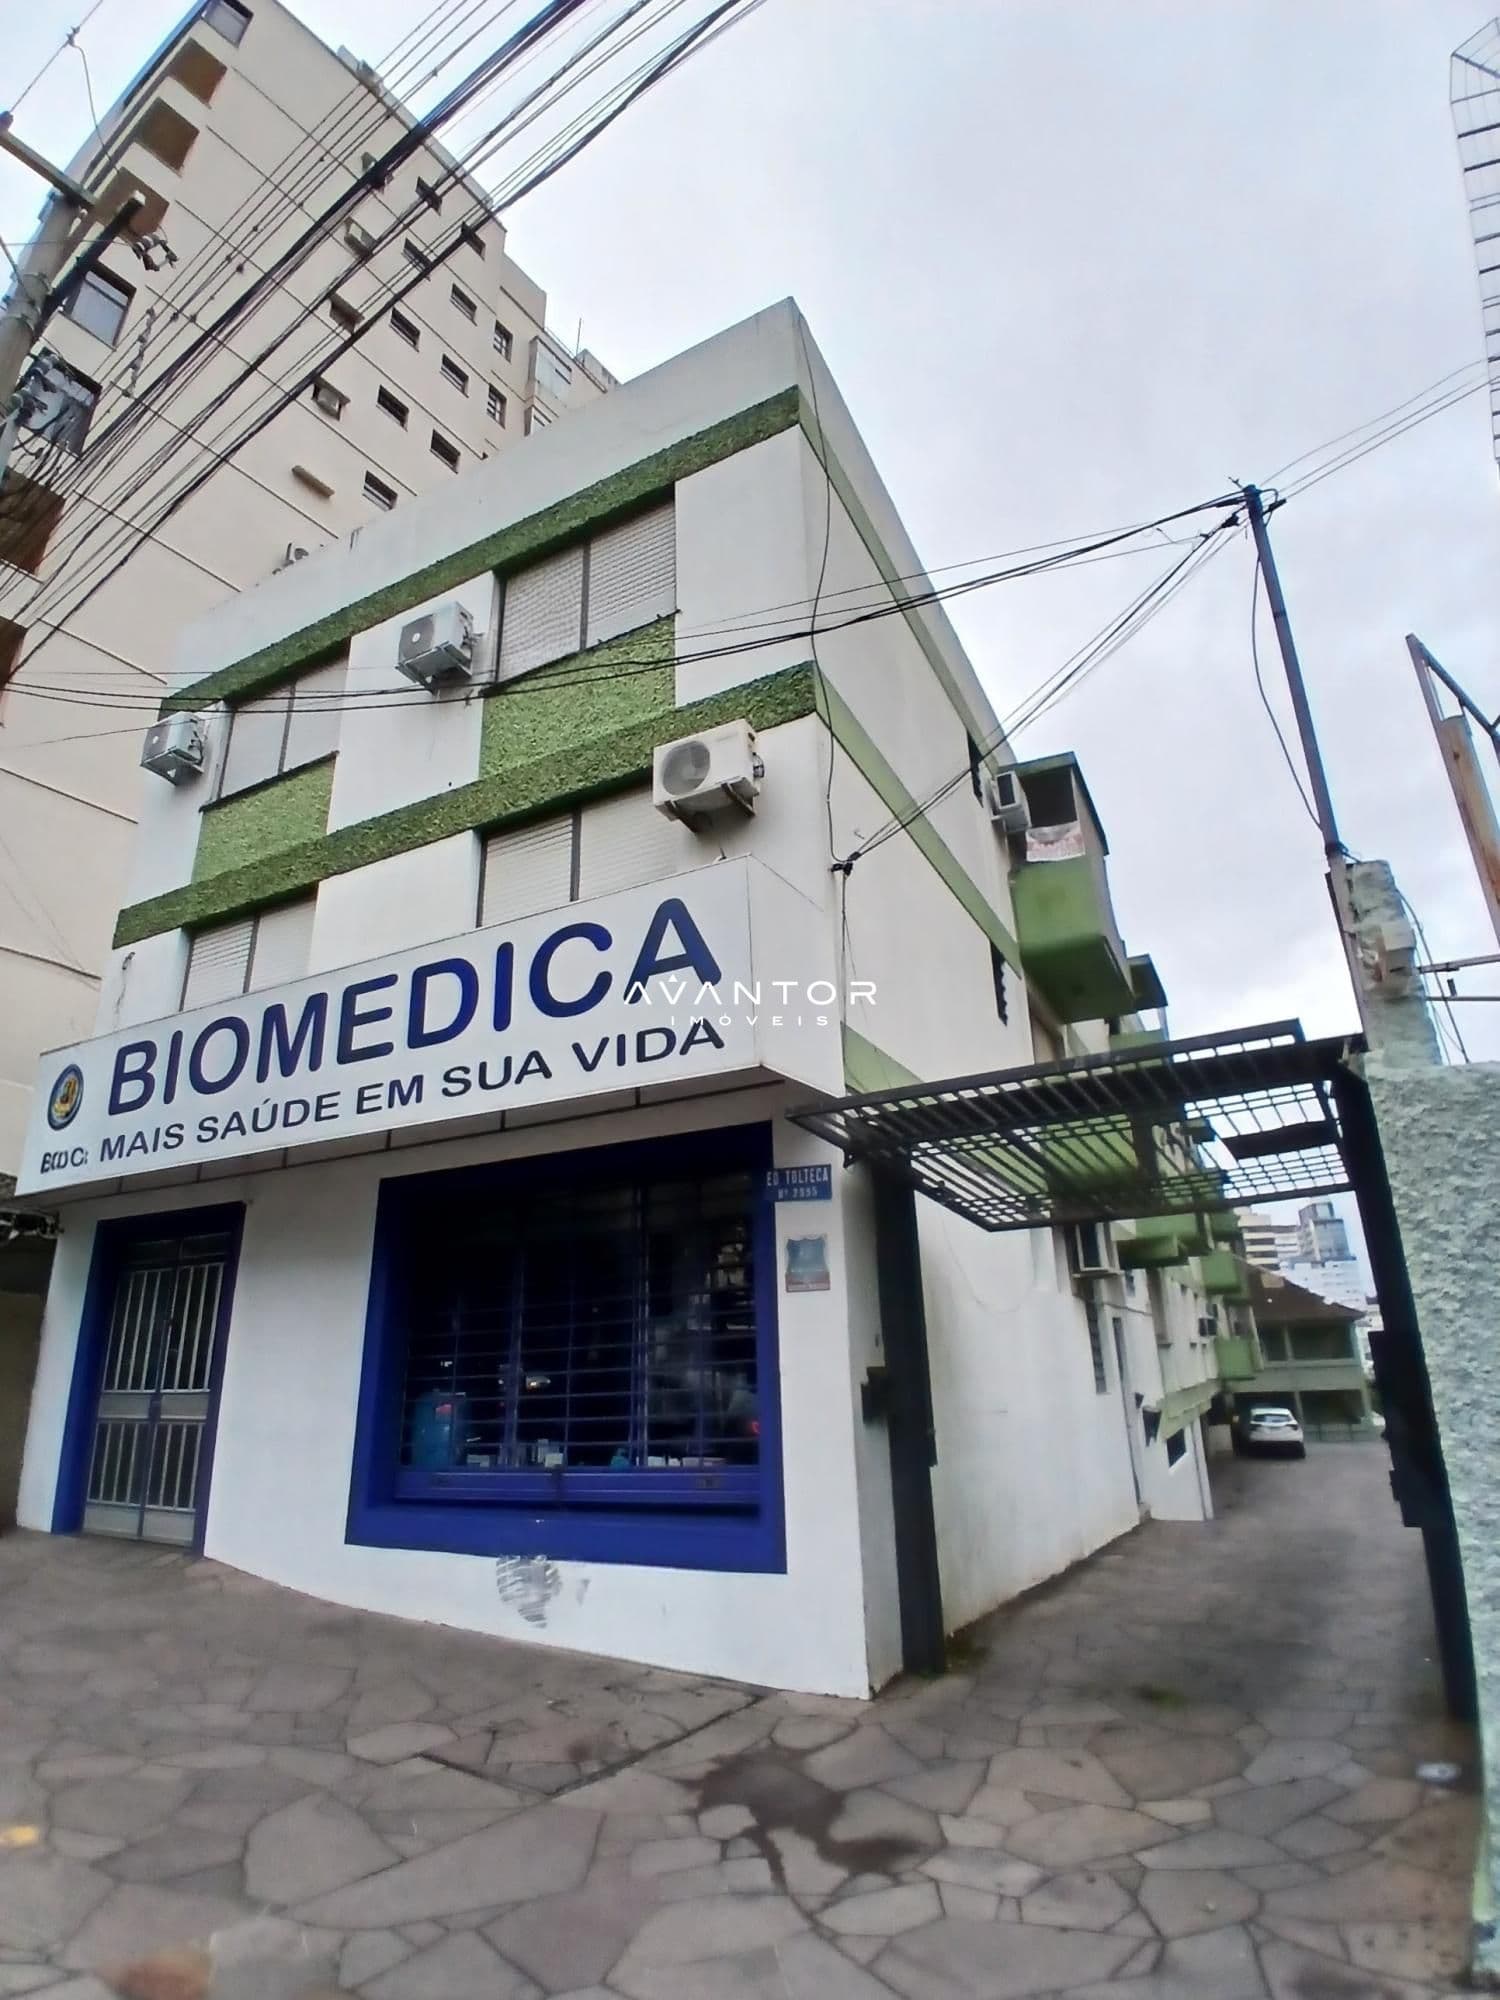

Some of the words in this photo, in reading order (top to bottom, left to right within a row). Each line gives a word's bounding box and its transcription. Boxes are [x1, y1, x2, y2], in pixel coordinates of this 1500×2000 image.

[108, 897, 723, 1117] BIOMEDICA
[99, 1123, 185, 1162] MAIS
[196, 1091, 341, 1143] SAÚDE
[356, 1074, 424, 1115] EM
[441, 1050, 553, 1097] SUA
[571, 1018, 725, 1073] VIDA
[785, 1167, 829, 1185] TOLTECA
